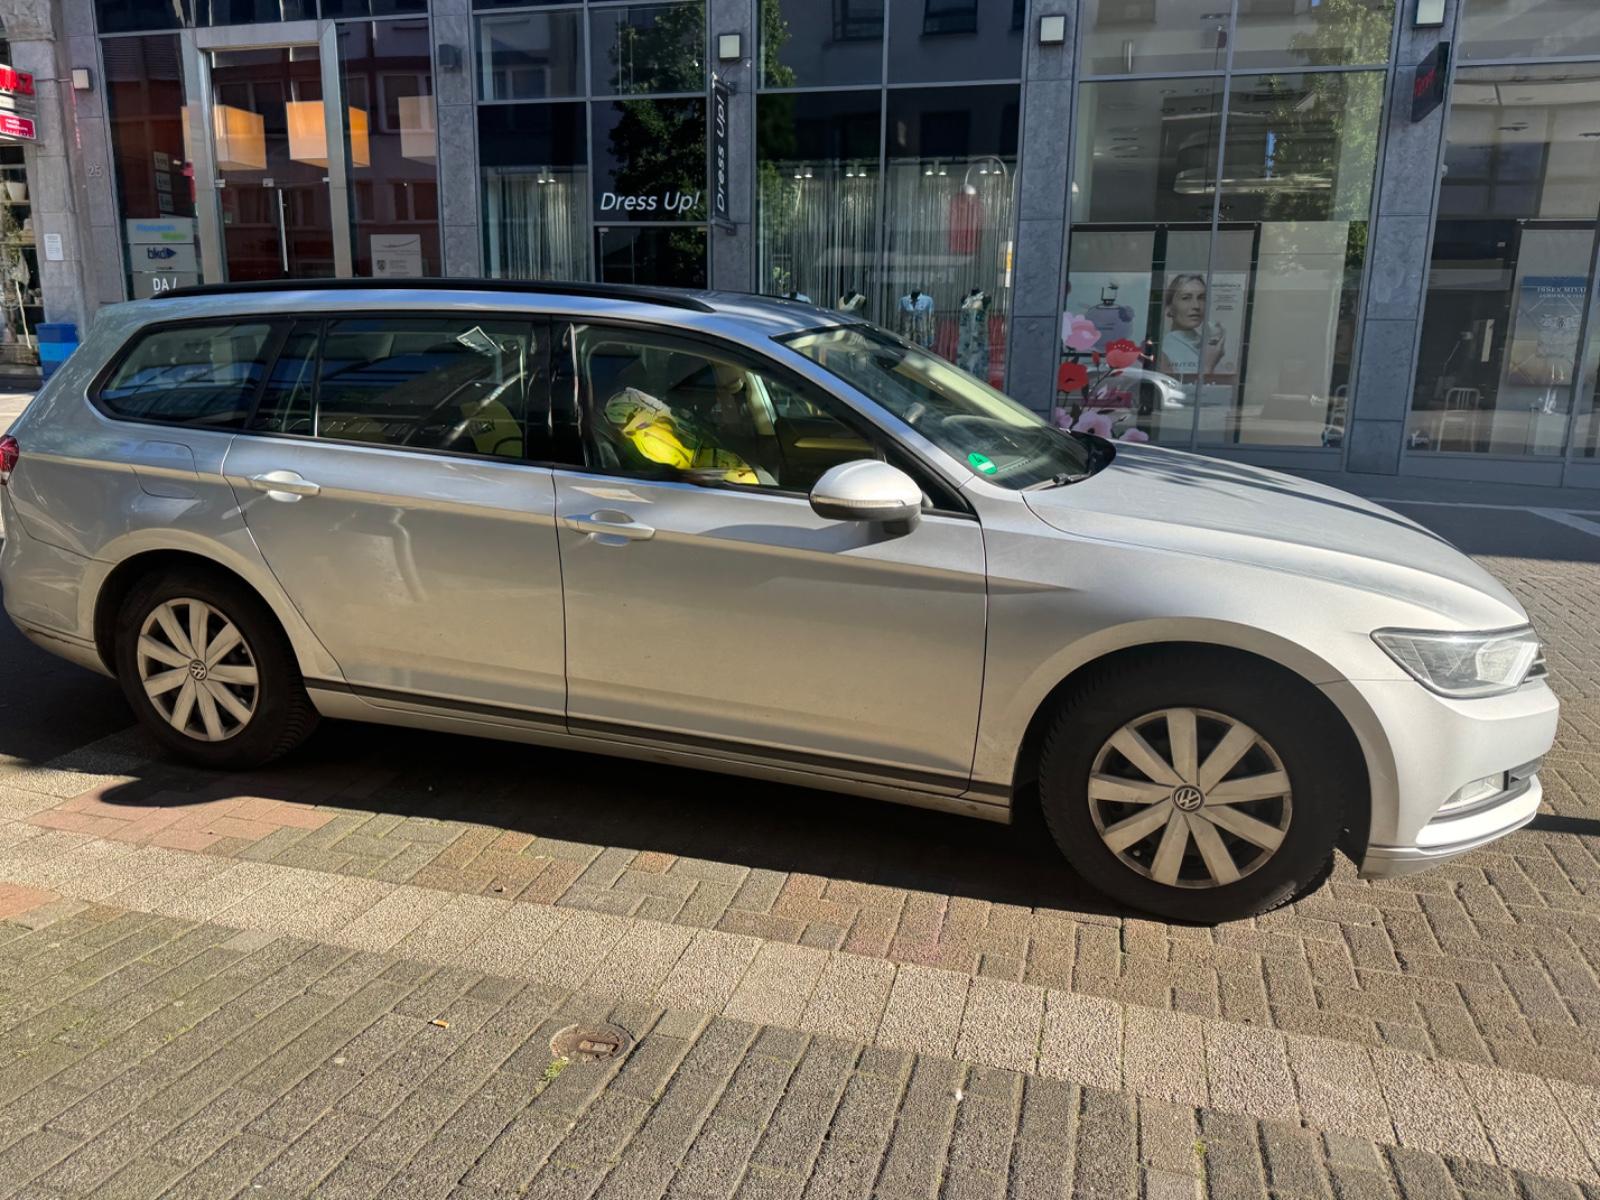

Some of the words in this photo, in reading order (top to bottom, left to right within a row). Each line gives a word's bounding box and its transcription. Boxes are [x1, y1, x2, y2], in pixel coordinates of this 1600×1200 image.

[716, 94, 725, 138] Up!
[717, 144, 725, 212] Dress
[600, 192, 658, 210] Dress
[664, 191, 700, 214] Up!
[152, 278, 170, 291] DA
